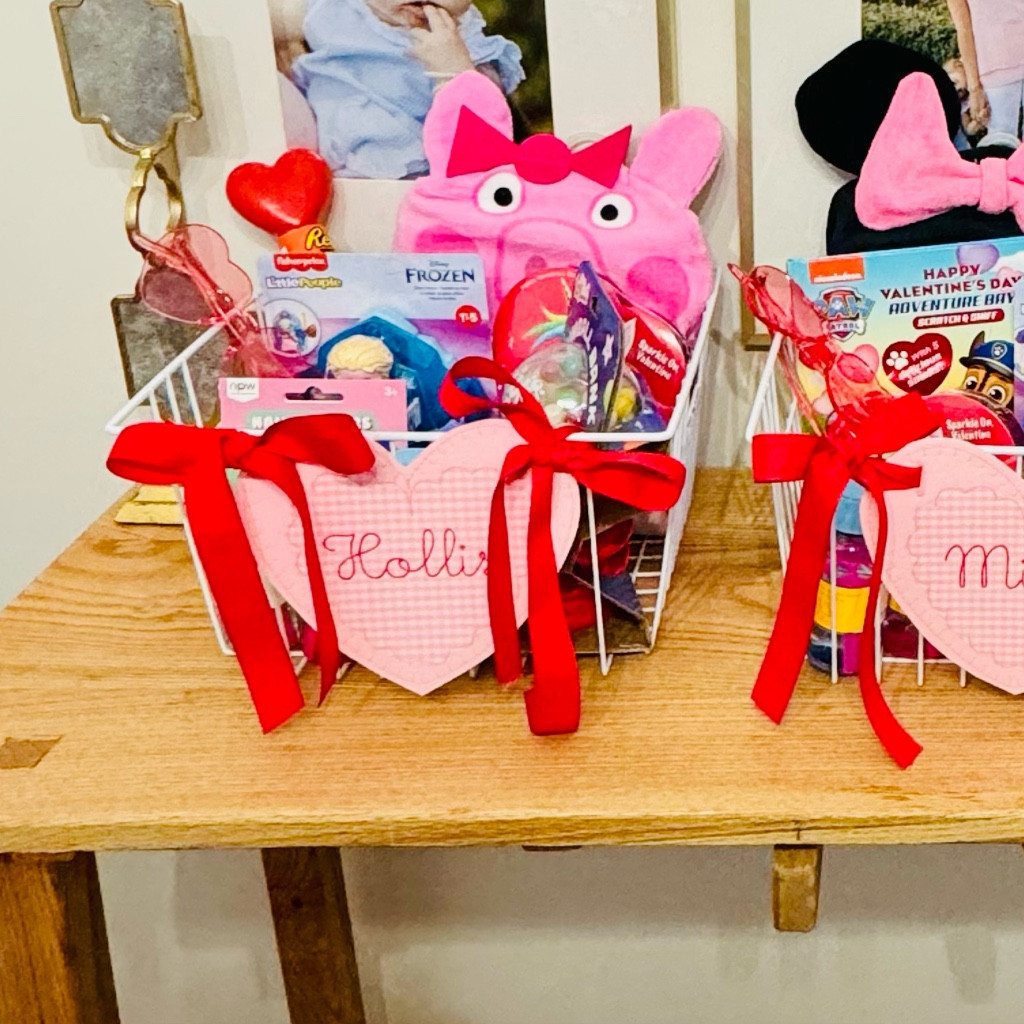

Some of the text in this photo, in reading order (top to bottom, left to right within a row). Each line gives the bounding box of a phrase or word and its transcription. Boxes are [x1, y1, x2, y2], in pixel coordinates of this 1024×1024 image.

[405, 267, 475, 284] FROZEN
[923, 264, 981, 280] HAPPY
[880, 275, 1023, 300] VALENTINE'S DAY
[889, 292, 1016, 315] ADVENTURE BAY
[917, 314, 961, 328] SCRATCH
[638, 338, 669, 365] Sparkle
[637, 351, 672, 380] Valentine
[229, 382, 256, 392] npw
[384, 386, 398, 397] 3+
[945, 417, 979, 431] Sparkle
